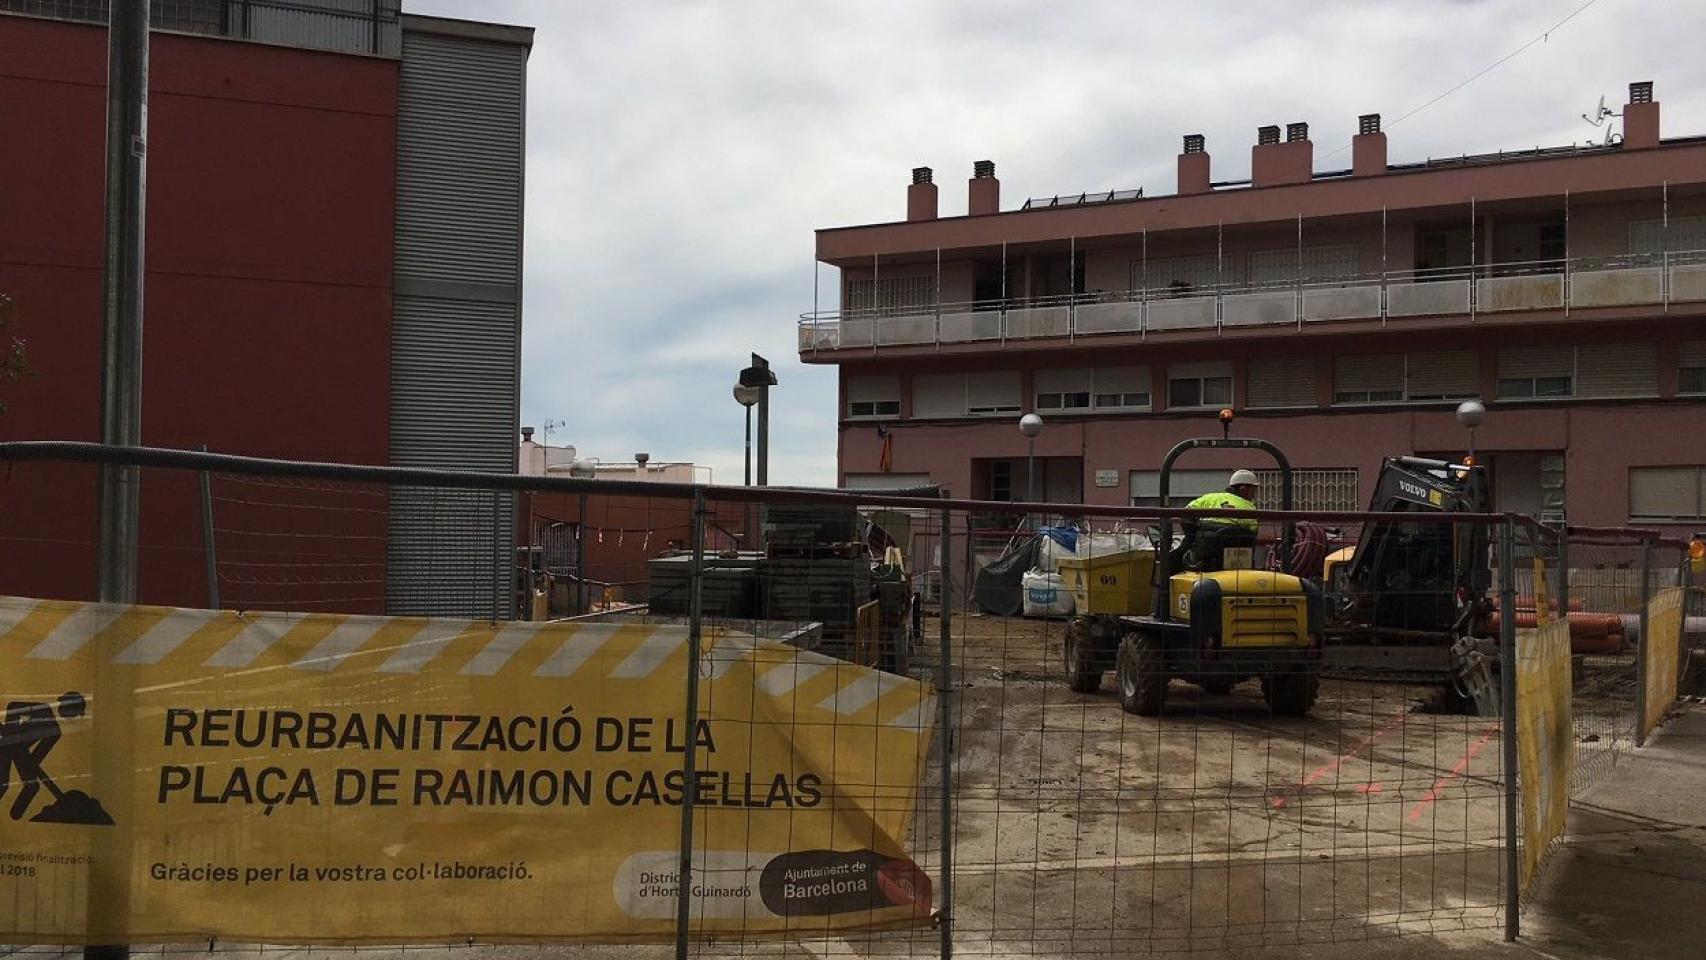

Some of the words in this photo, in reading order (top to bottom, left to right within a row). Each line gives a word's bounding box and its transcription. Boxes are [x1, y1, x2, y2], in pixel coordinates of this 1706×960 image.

[1399, 480, 1427, 498] VOLVO
[163, 705, 582, 753] REURBANITZACIÓ
[595, 717, 654, 753] DE
[665, 718, 717, 753] LA
[158, 765, 320, 816] PLAÇA
[333, 768, 400, 806] DE
[413, 768, 592, 808] RAIMON
[605, 769, 822, 809] CASELLAS
[8, 864, 36, 877] 2018
[150, 862, 239, 882] Gràcies
[245, 866, 284, 885] per
[288, 863, 308, 882] la
[312, 864, 387, 882] vostra
[393, 861, 534, 881] col·laboració.
[640, 871, 693, 884] Distric
[784, 865, 849, 882] Ajuntament
[851, 861, 867, 873] de
[784, 878, 868, 899] Barcelona
